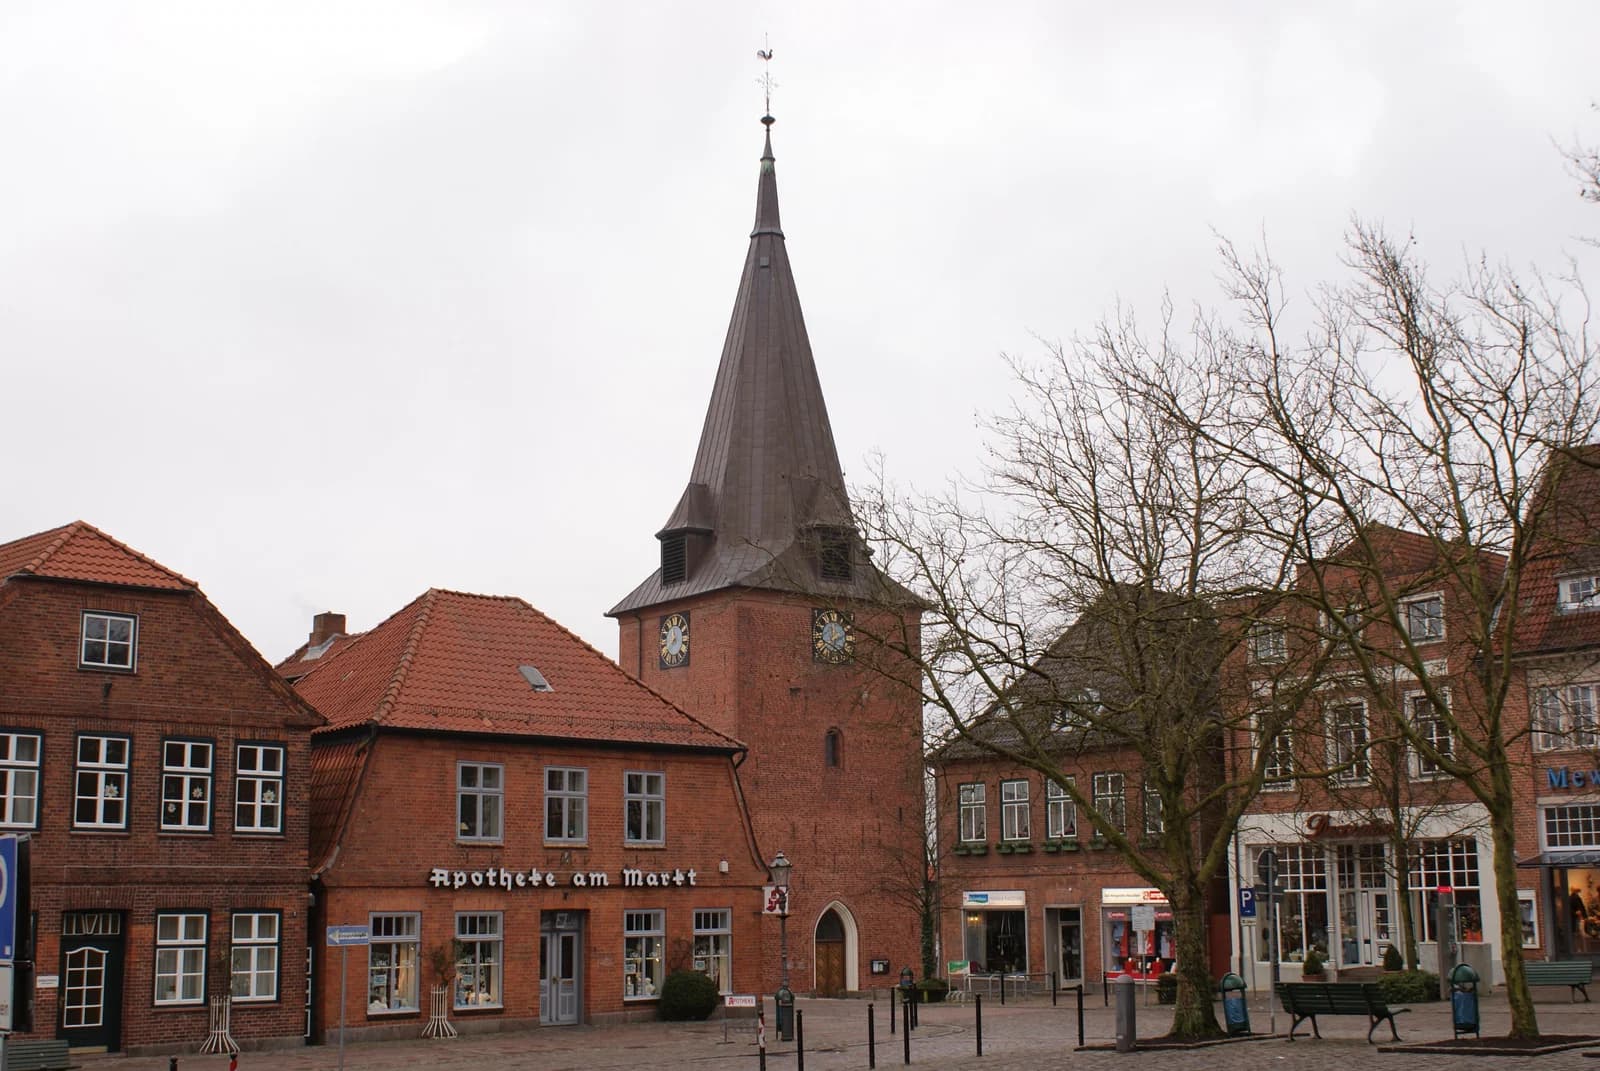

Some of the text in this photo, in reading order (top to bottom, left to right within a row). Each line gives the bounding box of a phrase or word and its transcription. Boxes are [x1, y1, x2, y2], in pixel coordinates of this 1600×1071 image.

[429, 868, 697, 891] Apotheke am Markt
[1241, 891, 1252, 908] P
